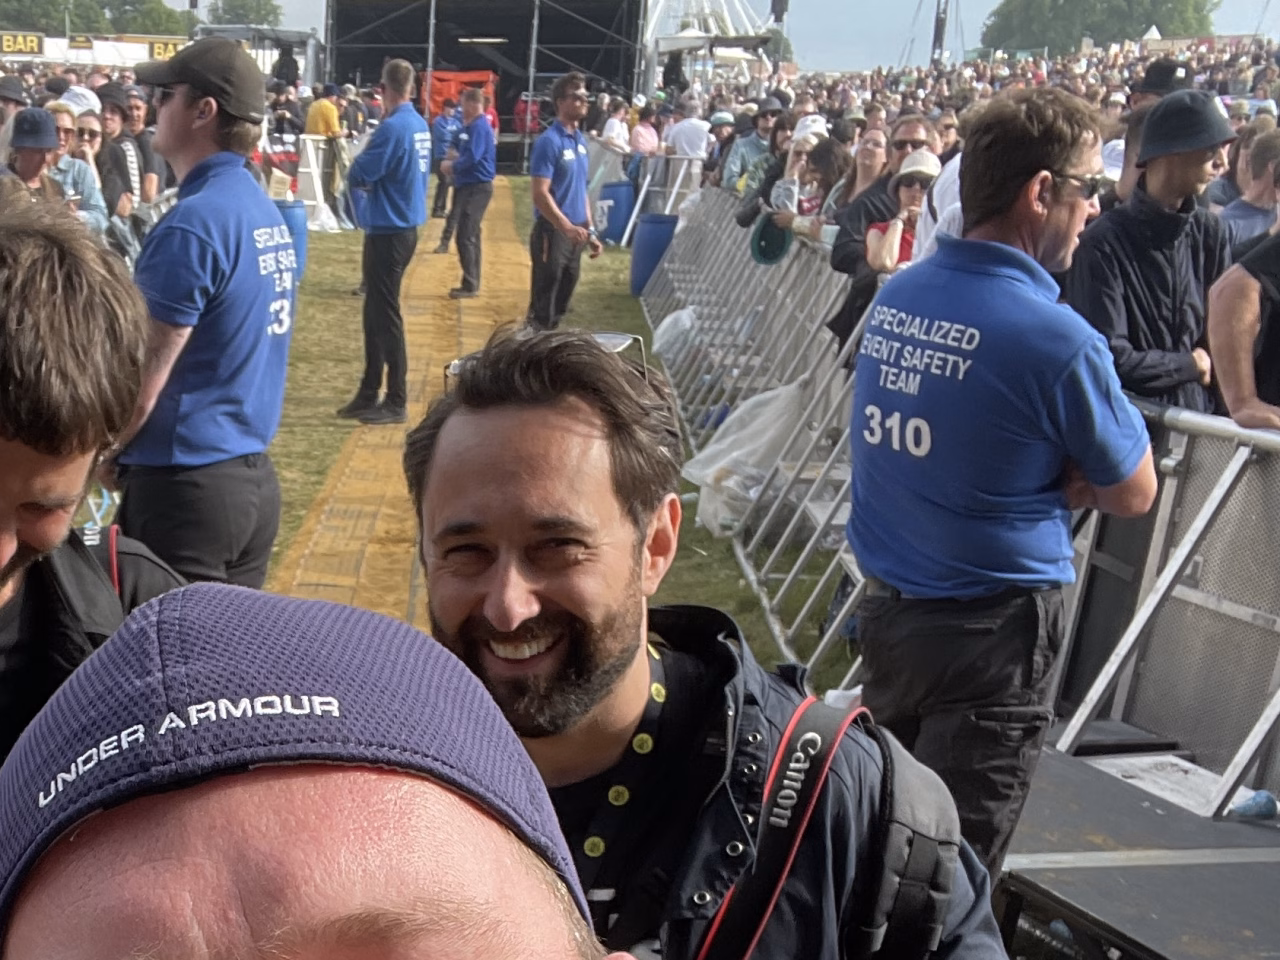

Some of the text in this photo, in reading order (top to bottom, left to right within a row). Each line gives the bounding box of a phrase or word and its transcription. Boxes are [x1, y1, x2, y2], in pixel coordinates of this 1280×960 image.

[2, 35, 39, 53] BAR
[153, 43, 184, 59] BA
[871, 305, 980, 351] SPECIALIZED
[860, 333, 972, 380] EVENT SAFETY
[879, 365, 922, 395] TEAM
[863, 404, 932, 458] 310
[38, 695, 340, 808] UNDER ARMOUR
[769, 732, 822, 828] Canon
